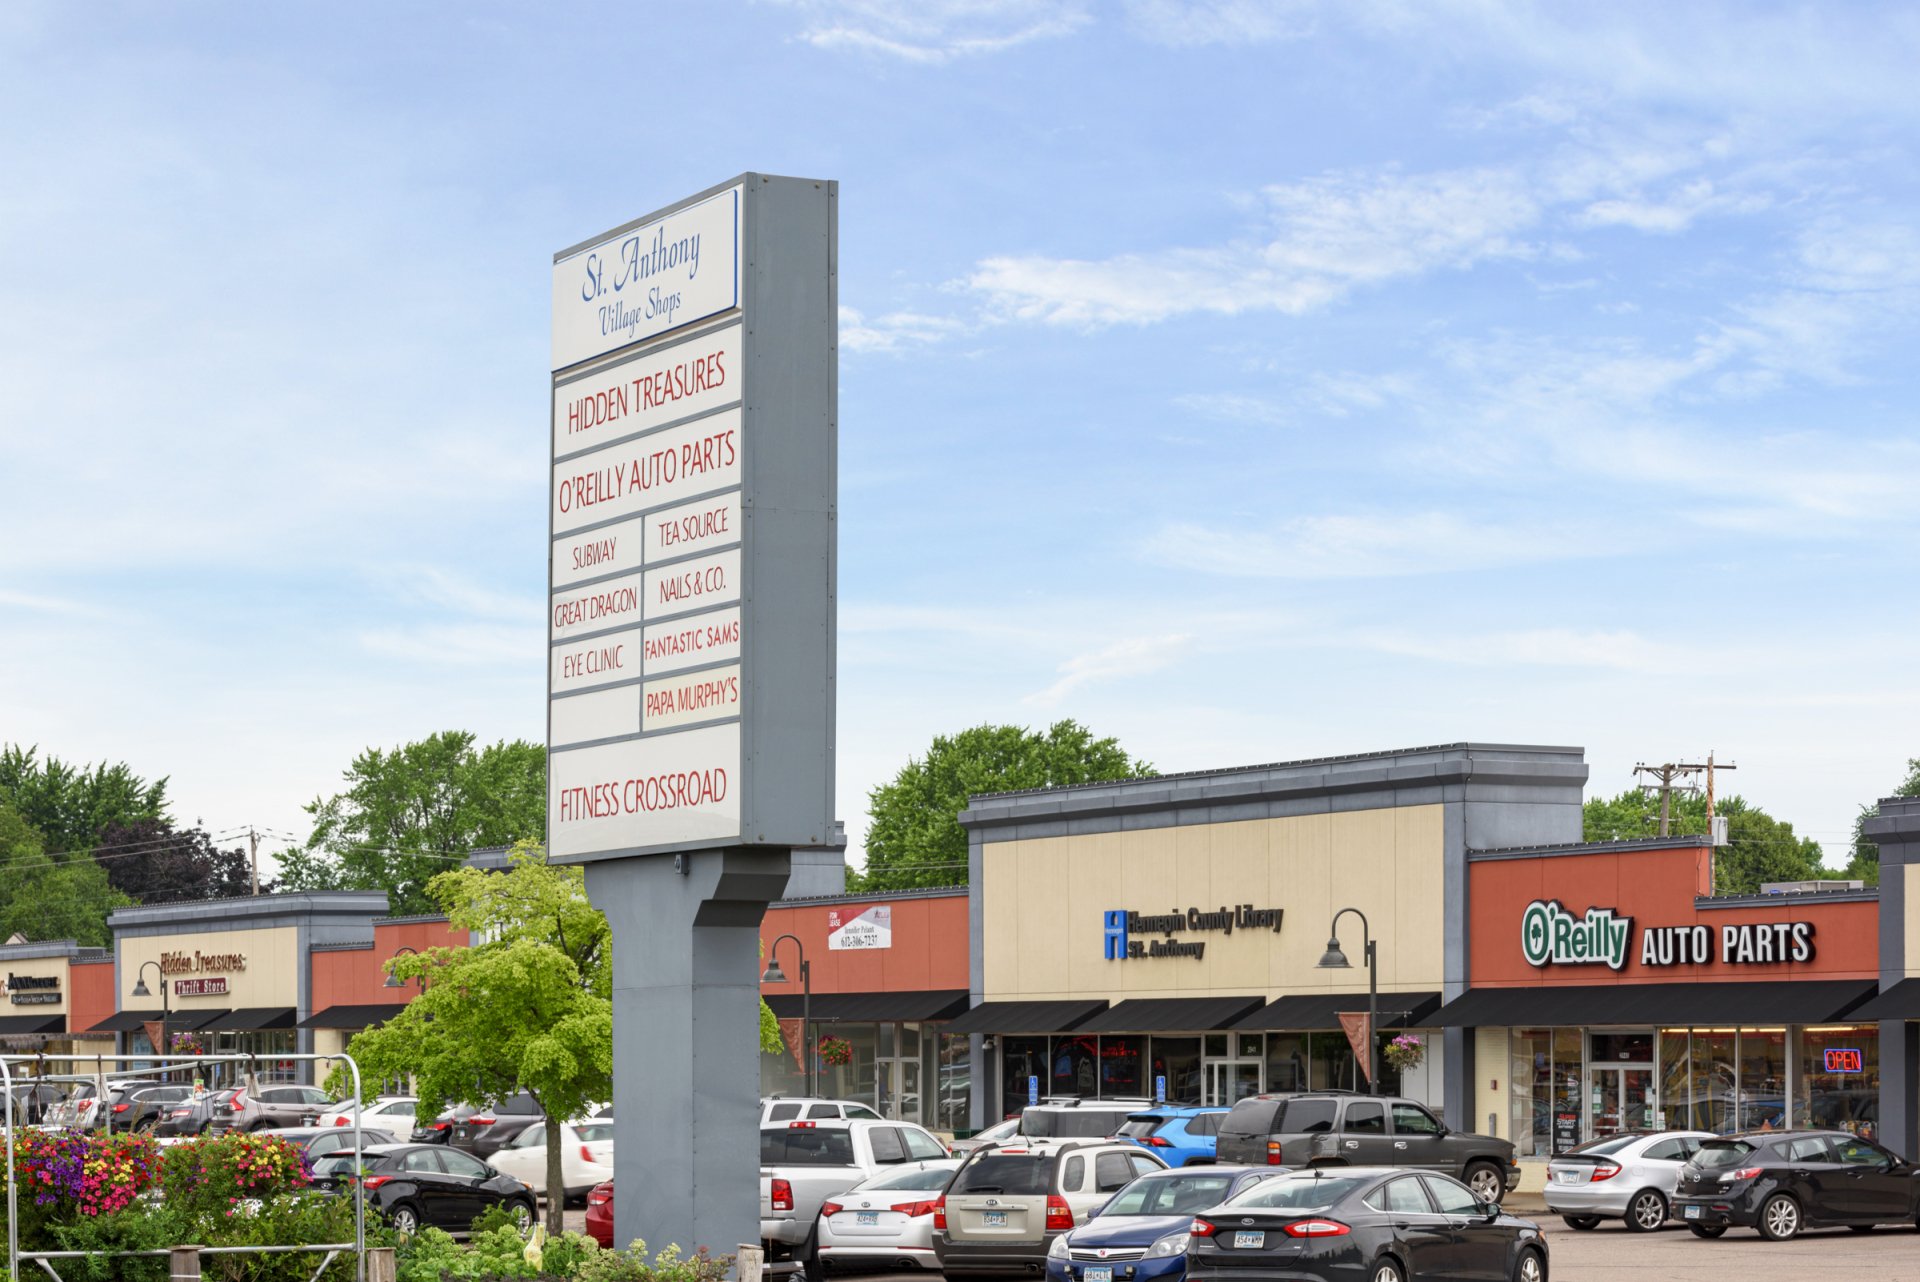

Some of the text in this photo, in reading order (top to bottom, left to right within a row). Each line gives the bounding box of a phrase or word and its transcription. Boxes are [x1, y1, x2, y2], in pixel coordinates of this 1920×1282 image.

[582, 226, 701, 302] St. Anthony
[599, 288, 681, 339] Village Shops
[568, 351, 726, 434] HIDDEN TREASURES
[559, 430, 735, 513] O'REILLY AUTO PARTS
[659, 507, 729, 547] TEA SOURCE
[572, 537, 617, 570] SUBWAY
[659, 566, 727, 604] NAILS & CO.
[554, 587, 638, 628] GREAT DRAGON
[644, 621, 740, 660] FANTASTIC SAMS
[564, 645, 624, 679] EYE CLINIC
[646, 676, 738, 718] PAPA MURPHY'S
[560, 768, 727, 822] FITNESS CROSSROAD
[1127, 904, 1284, 937] Hennepin County Library
[1522, 899, 1812, 972] O'Reilly AUTO PARTS
[160, 949, 247, 976] Hidden Treasures
[1128, 938, 1206, 960] St. Anthony
[176, 979, 225, 995] Thrift Store
[1825, 1051, 1861, 1070] OPEN
